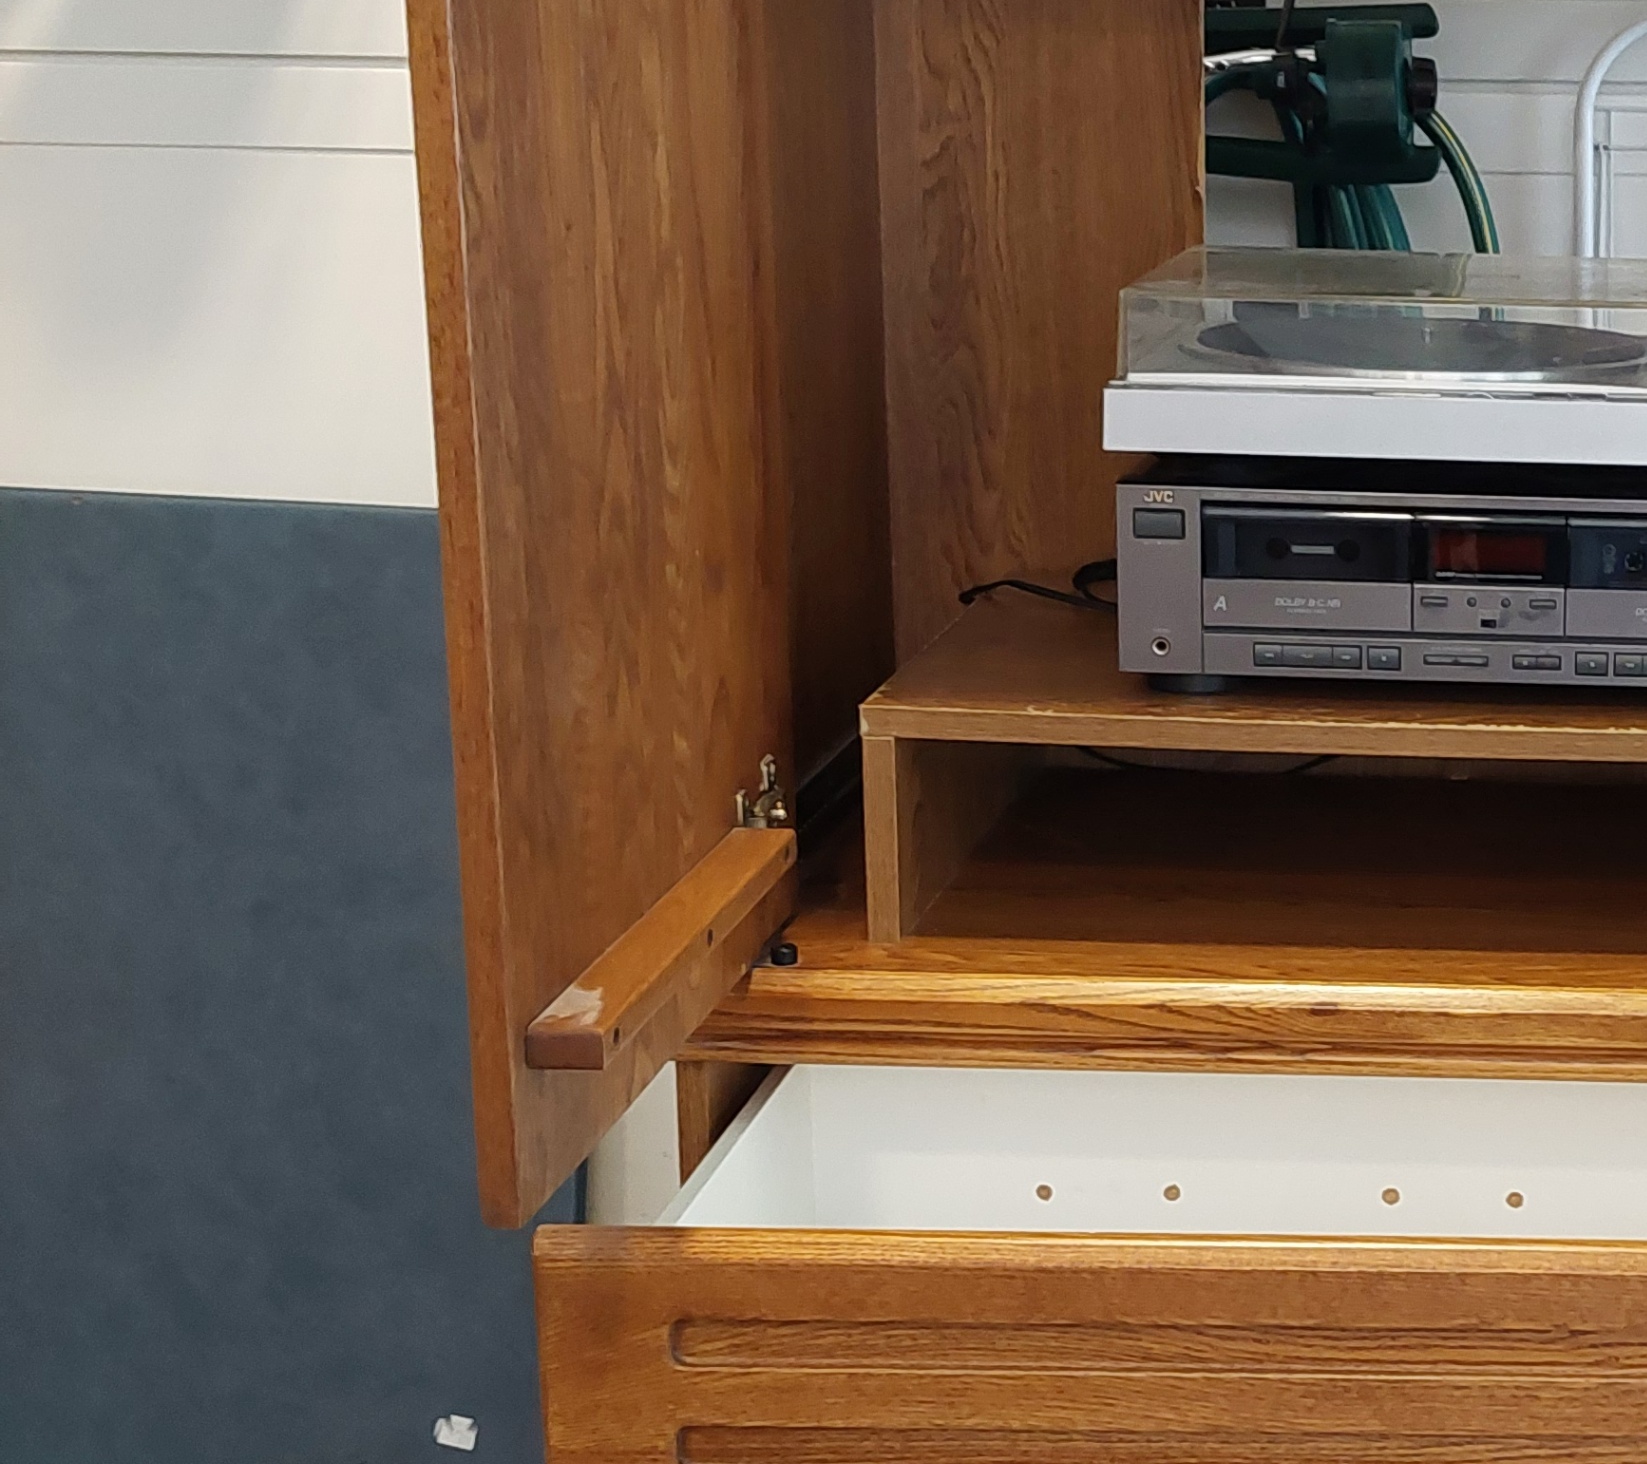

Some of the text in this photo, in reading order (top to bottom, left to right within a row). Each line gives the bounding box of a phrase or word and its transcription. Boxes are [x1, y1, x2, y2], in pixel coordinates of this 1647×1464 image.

[1143, 490, 1174, 504] JVC
[1213, 595, 1228, 612] A
[1274, 597, 1307, 607] DOLBY
